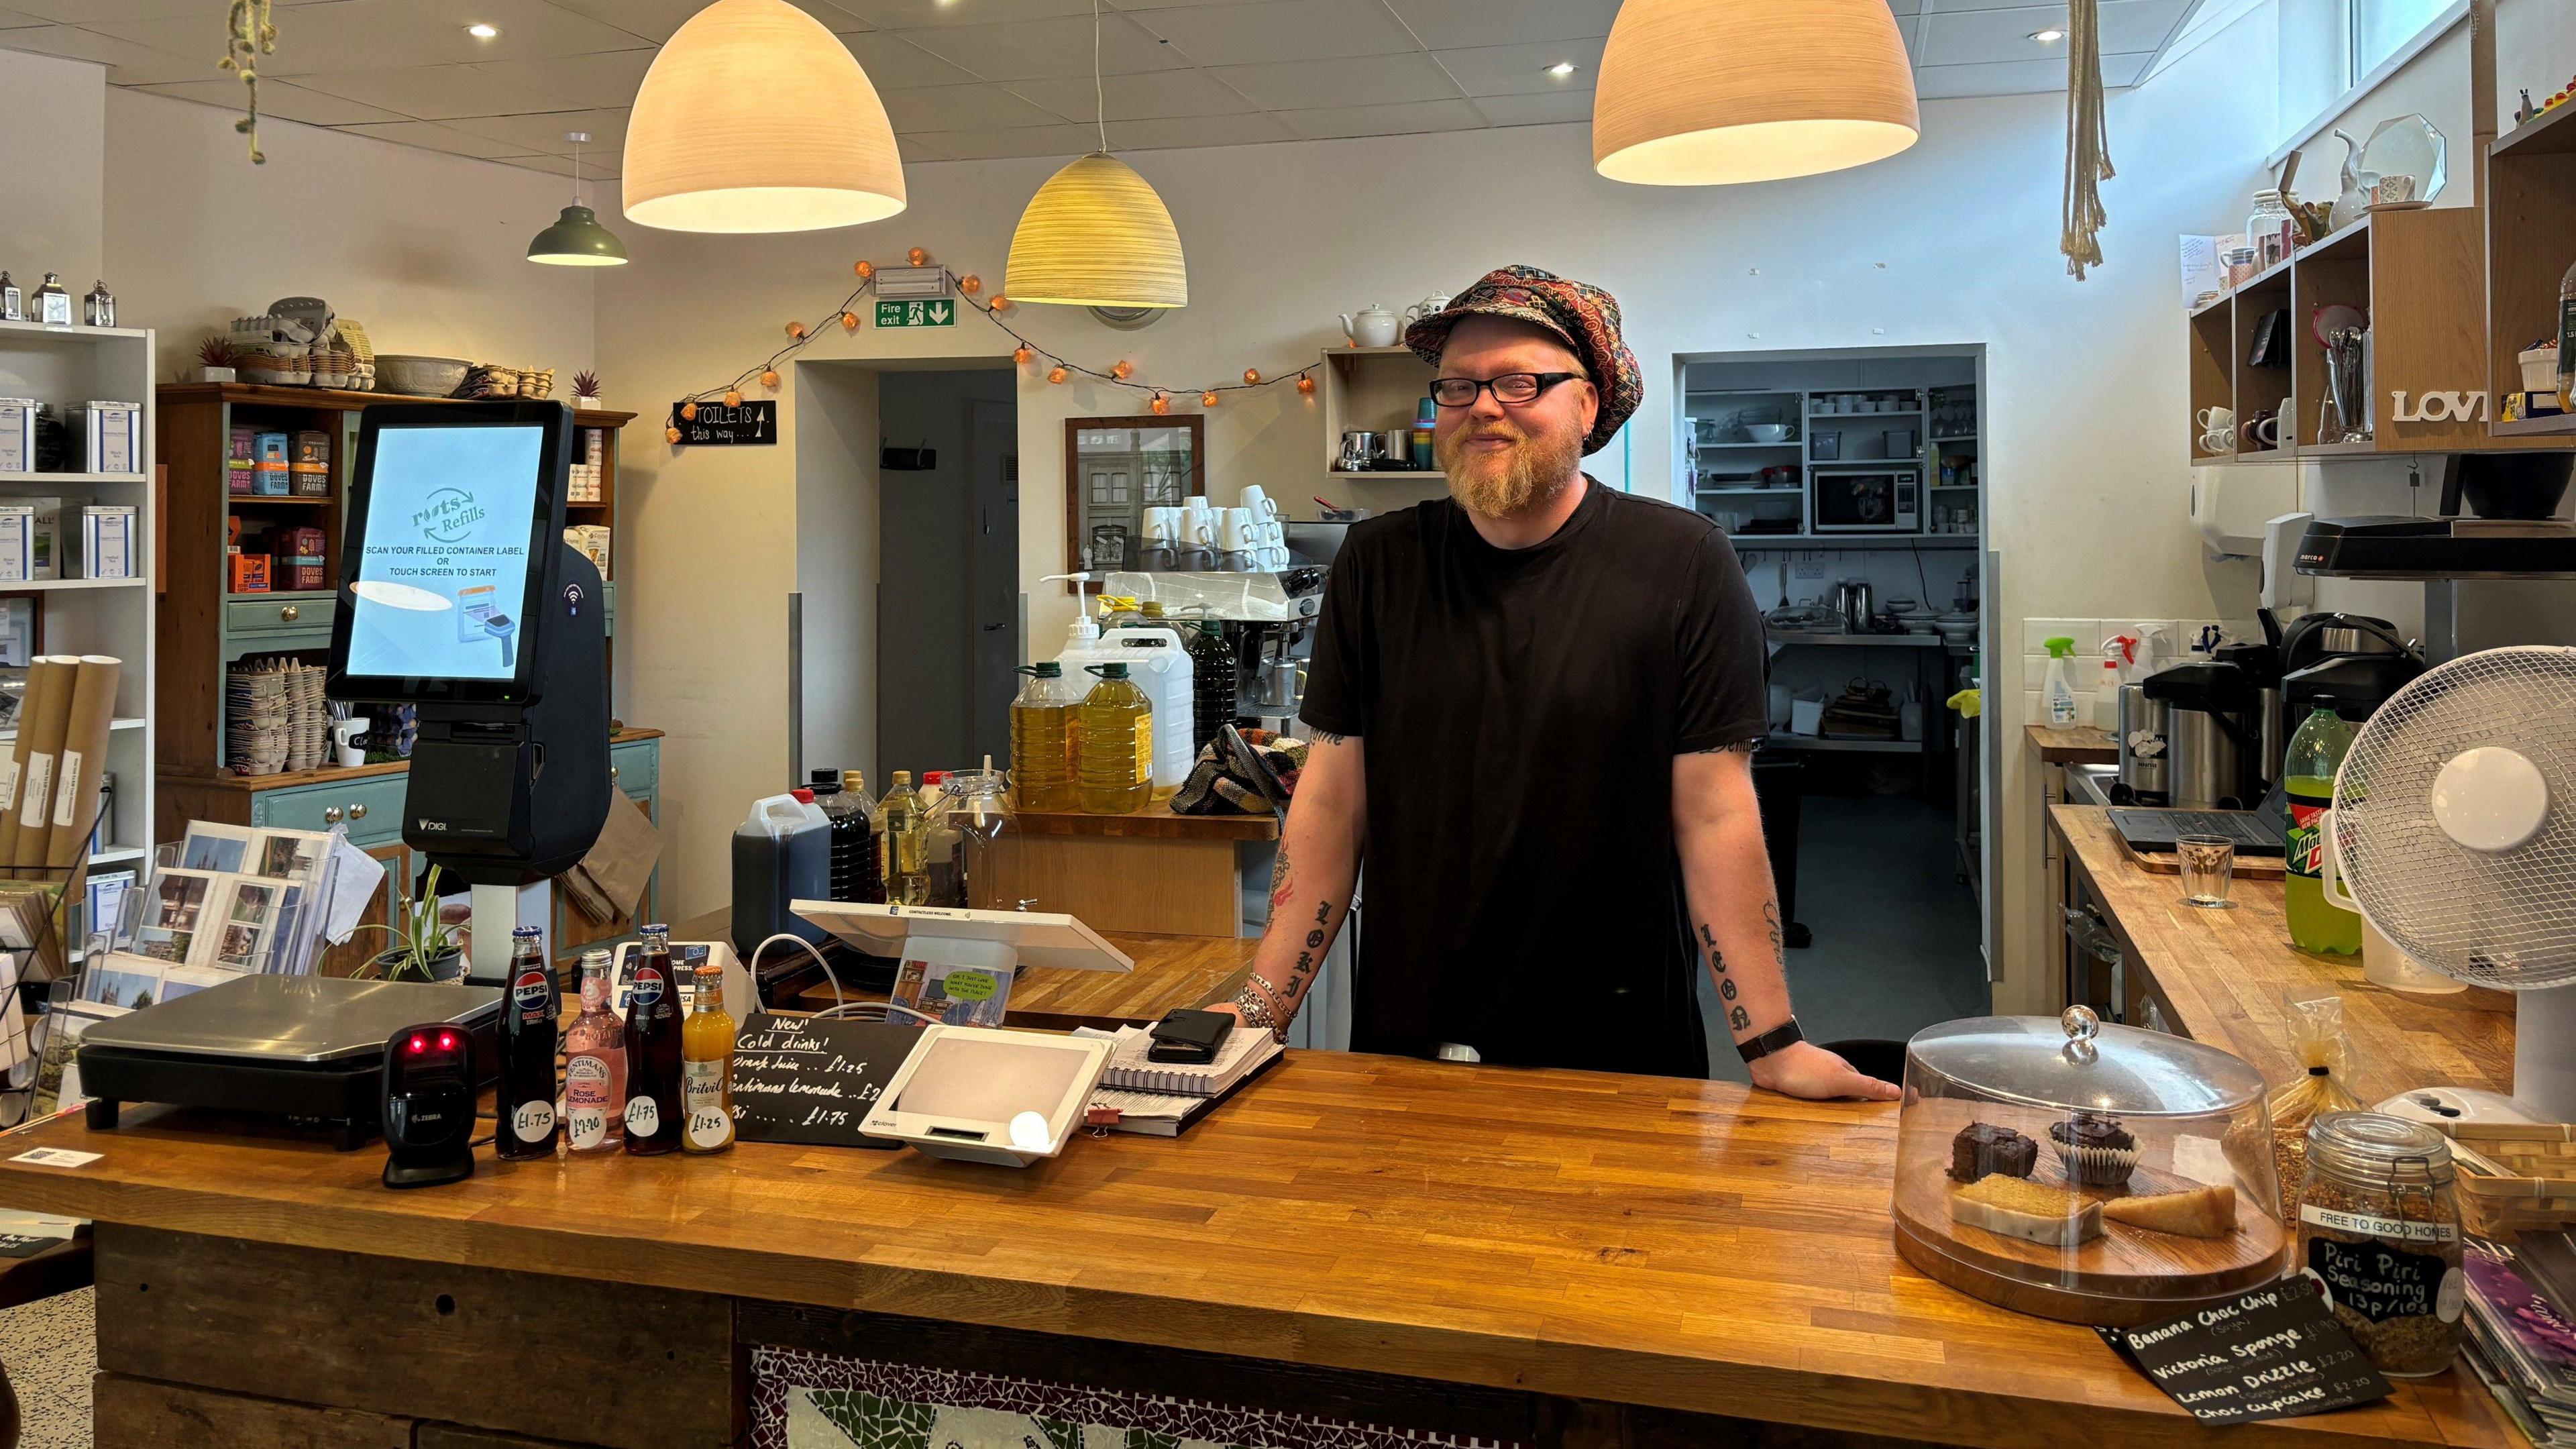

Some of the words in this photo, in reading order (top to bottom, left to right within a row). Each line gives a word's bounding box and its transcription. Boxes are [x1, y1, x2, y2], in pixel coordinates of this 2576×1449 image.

[881, 304, 900, 313] Fire
[881, 315, 900, 325] exit
[696, 407, 751, 424] TOILETS
[692, 425, 709, 440] this
[303, 474, 326, 484] DOVES
[441, 506, 486, 533] Refills
[366, 546, 388, 555] SCAN
[391, 547, 414, 555] YOUR
[415, 547, 444, 555] FILLED
[446, 547, 494, 555] CONTAINER
[496, 547, 525, 555] LABEL
[436, 557, 449, 566] OR
[302, 567, 323, 576] DOVES
[389, 568, 419, 576] TOUCH
[420, 568, 454, 576] SCREEN
[456, 568, 468, 576] TO
[469, 568, 497, 576] START
[2300, 814, 2310, 824] SAME
[2302, 820, 2312, 830] NEW
[515, 985, 547, 997] PEPSI
[634, 981, 662, 991] PEPSI
[523, 1010, 545, 1020] MAX
[771, 1018, 809, 1031] New!
[737, 1033, 775, 1049] Cold
[781, 1037, 829, 1051] drinks!
[824, 1055, 867, 1075] £1.25
[574, 1089, 596, 1097] ROSE
[421, 1113, 442, 1122] ZEBRA
[625, 1102, 655, 1123] £1.75
[802, 1106, 849, 1126] £1.75
[517, 1112, 551, 1130] £1.75
[692, 1114, 721, 1133] £1.25
[2320, 1212, 2349, 1226] FREE
[2351, 1218, 2369, 1230] TO
[2373, 1221, 2412, 1236] GOOD
[2415, 1226, 2451, 1238] HOMES
[2324, 1242, 2362, 1273] Piri
[2376, 1253, 2421, 1281] Piri
[2327, 1265, 2425, 1303] Seasoning
[2127, 1320, 2194, 1350] Banana
[2198, 1305, 2241, 1326] Choc
[2240, 1292, 2279, 1311] Chip
[2152, 1353, 2229, 1380] Victoria
[2230, 1328, 2303, 1358] Sponge
[2176, 1385, 2241, 1403] Lemon
[2242, 1360, 2317, 1389] Drizzle
[2194, 1407, 2243, 1419] Choc
